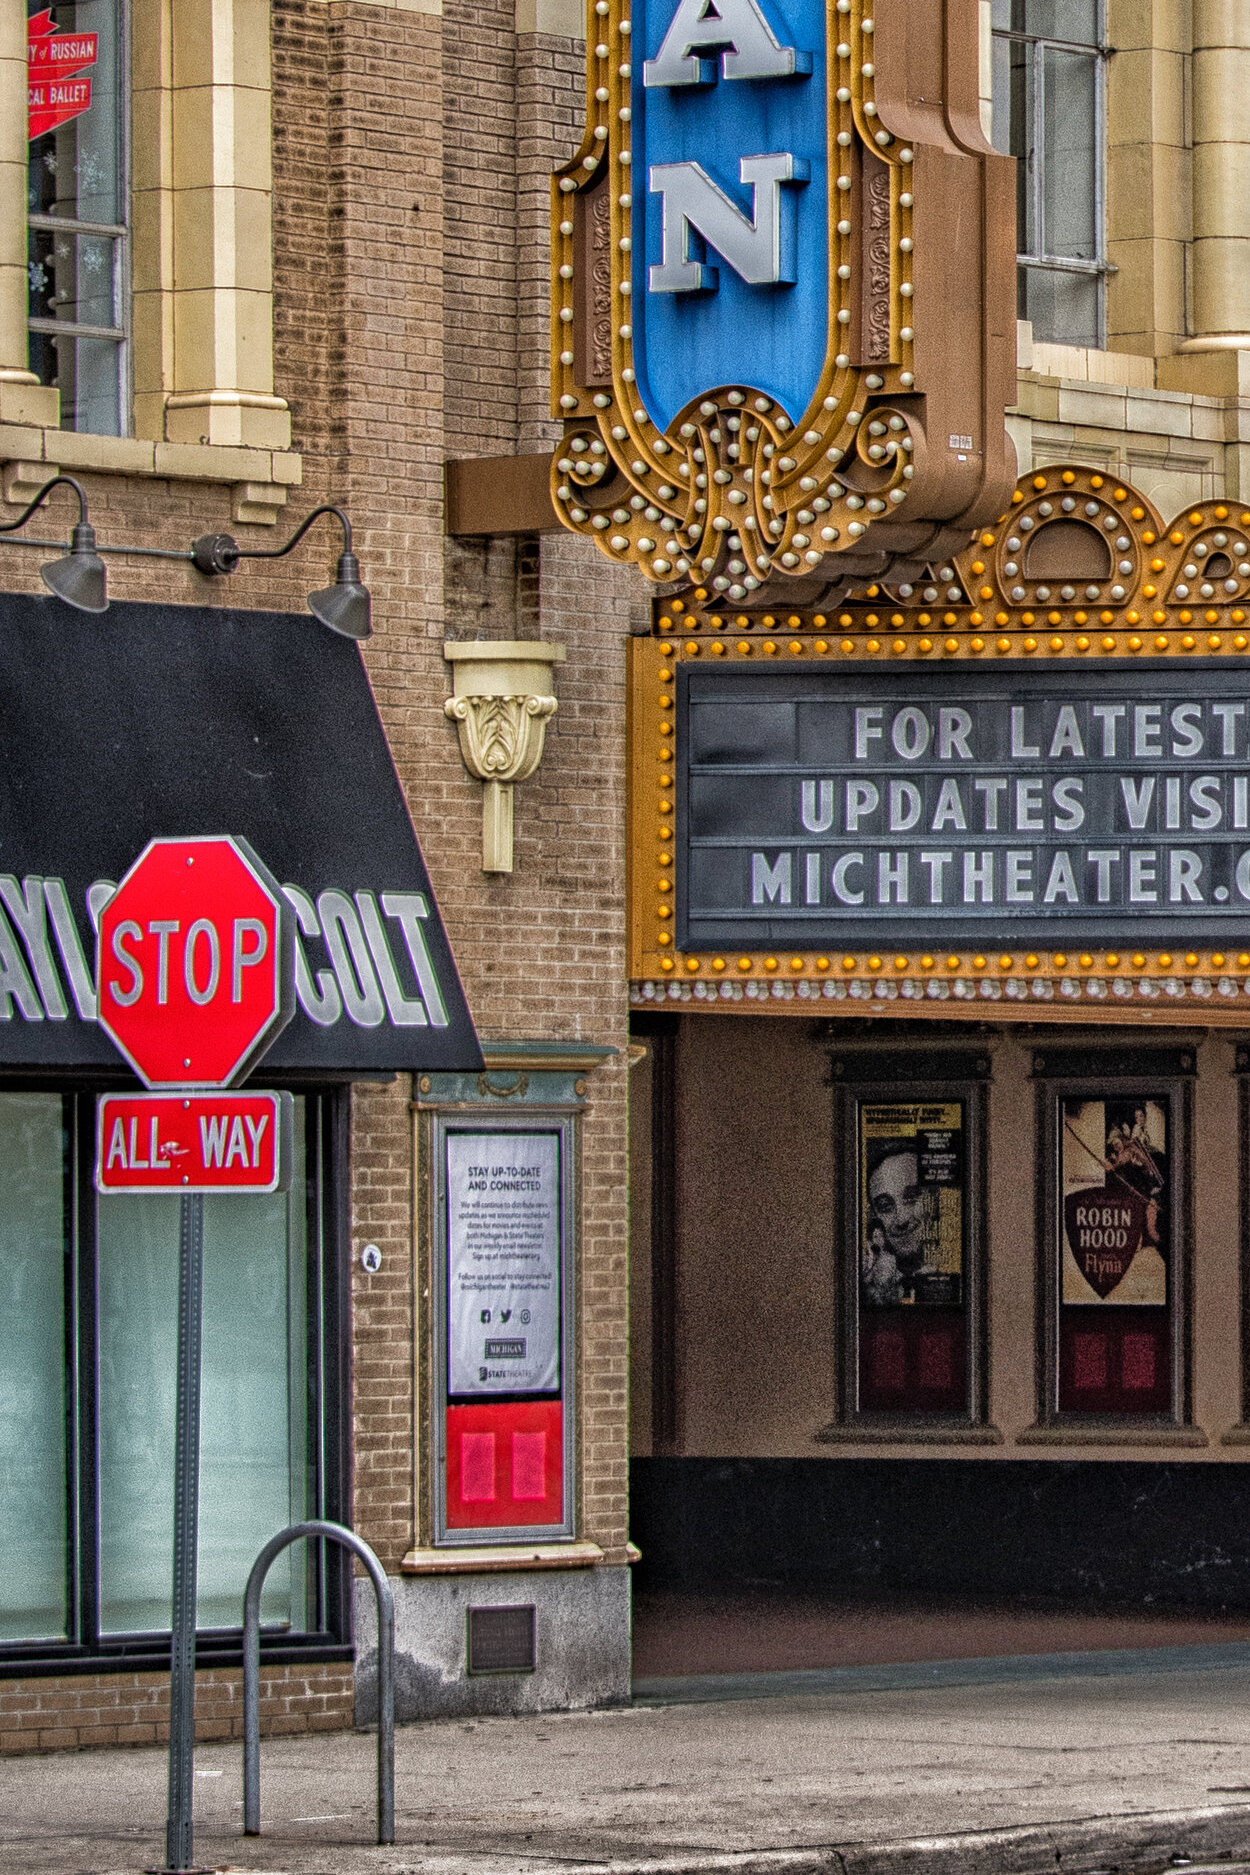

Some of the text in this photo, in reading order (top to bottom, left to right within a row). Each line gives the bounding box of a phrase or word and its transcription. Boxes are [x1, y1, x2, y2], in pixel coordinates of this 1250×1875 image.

[50, 40, 94, 60] RUSSIAN
[49, 85, 87, 104] BALLET
[854, 703, 1246, 759] FOR LATEST
[801, 777, 1085, 831] UPDATES
[108, 918, 268, 1008] STOP
[281, 882, 450, 1027] COLT
[106, 1114, 269, 1170] ALL WAY
[468, 1166, 541, 1177] STAY UP-TO-DATE
[468, 1180, 541, 1191] AND CONNECTED
[1076, 1206, 1132, 1227] ROBIN
[1080, 1228, 1127, 1247] HOOD
